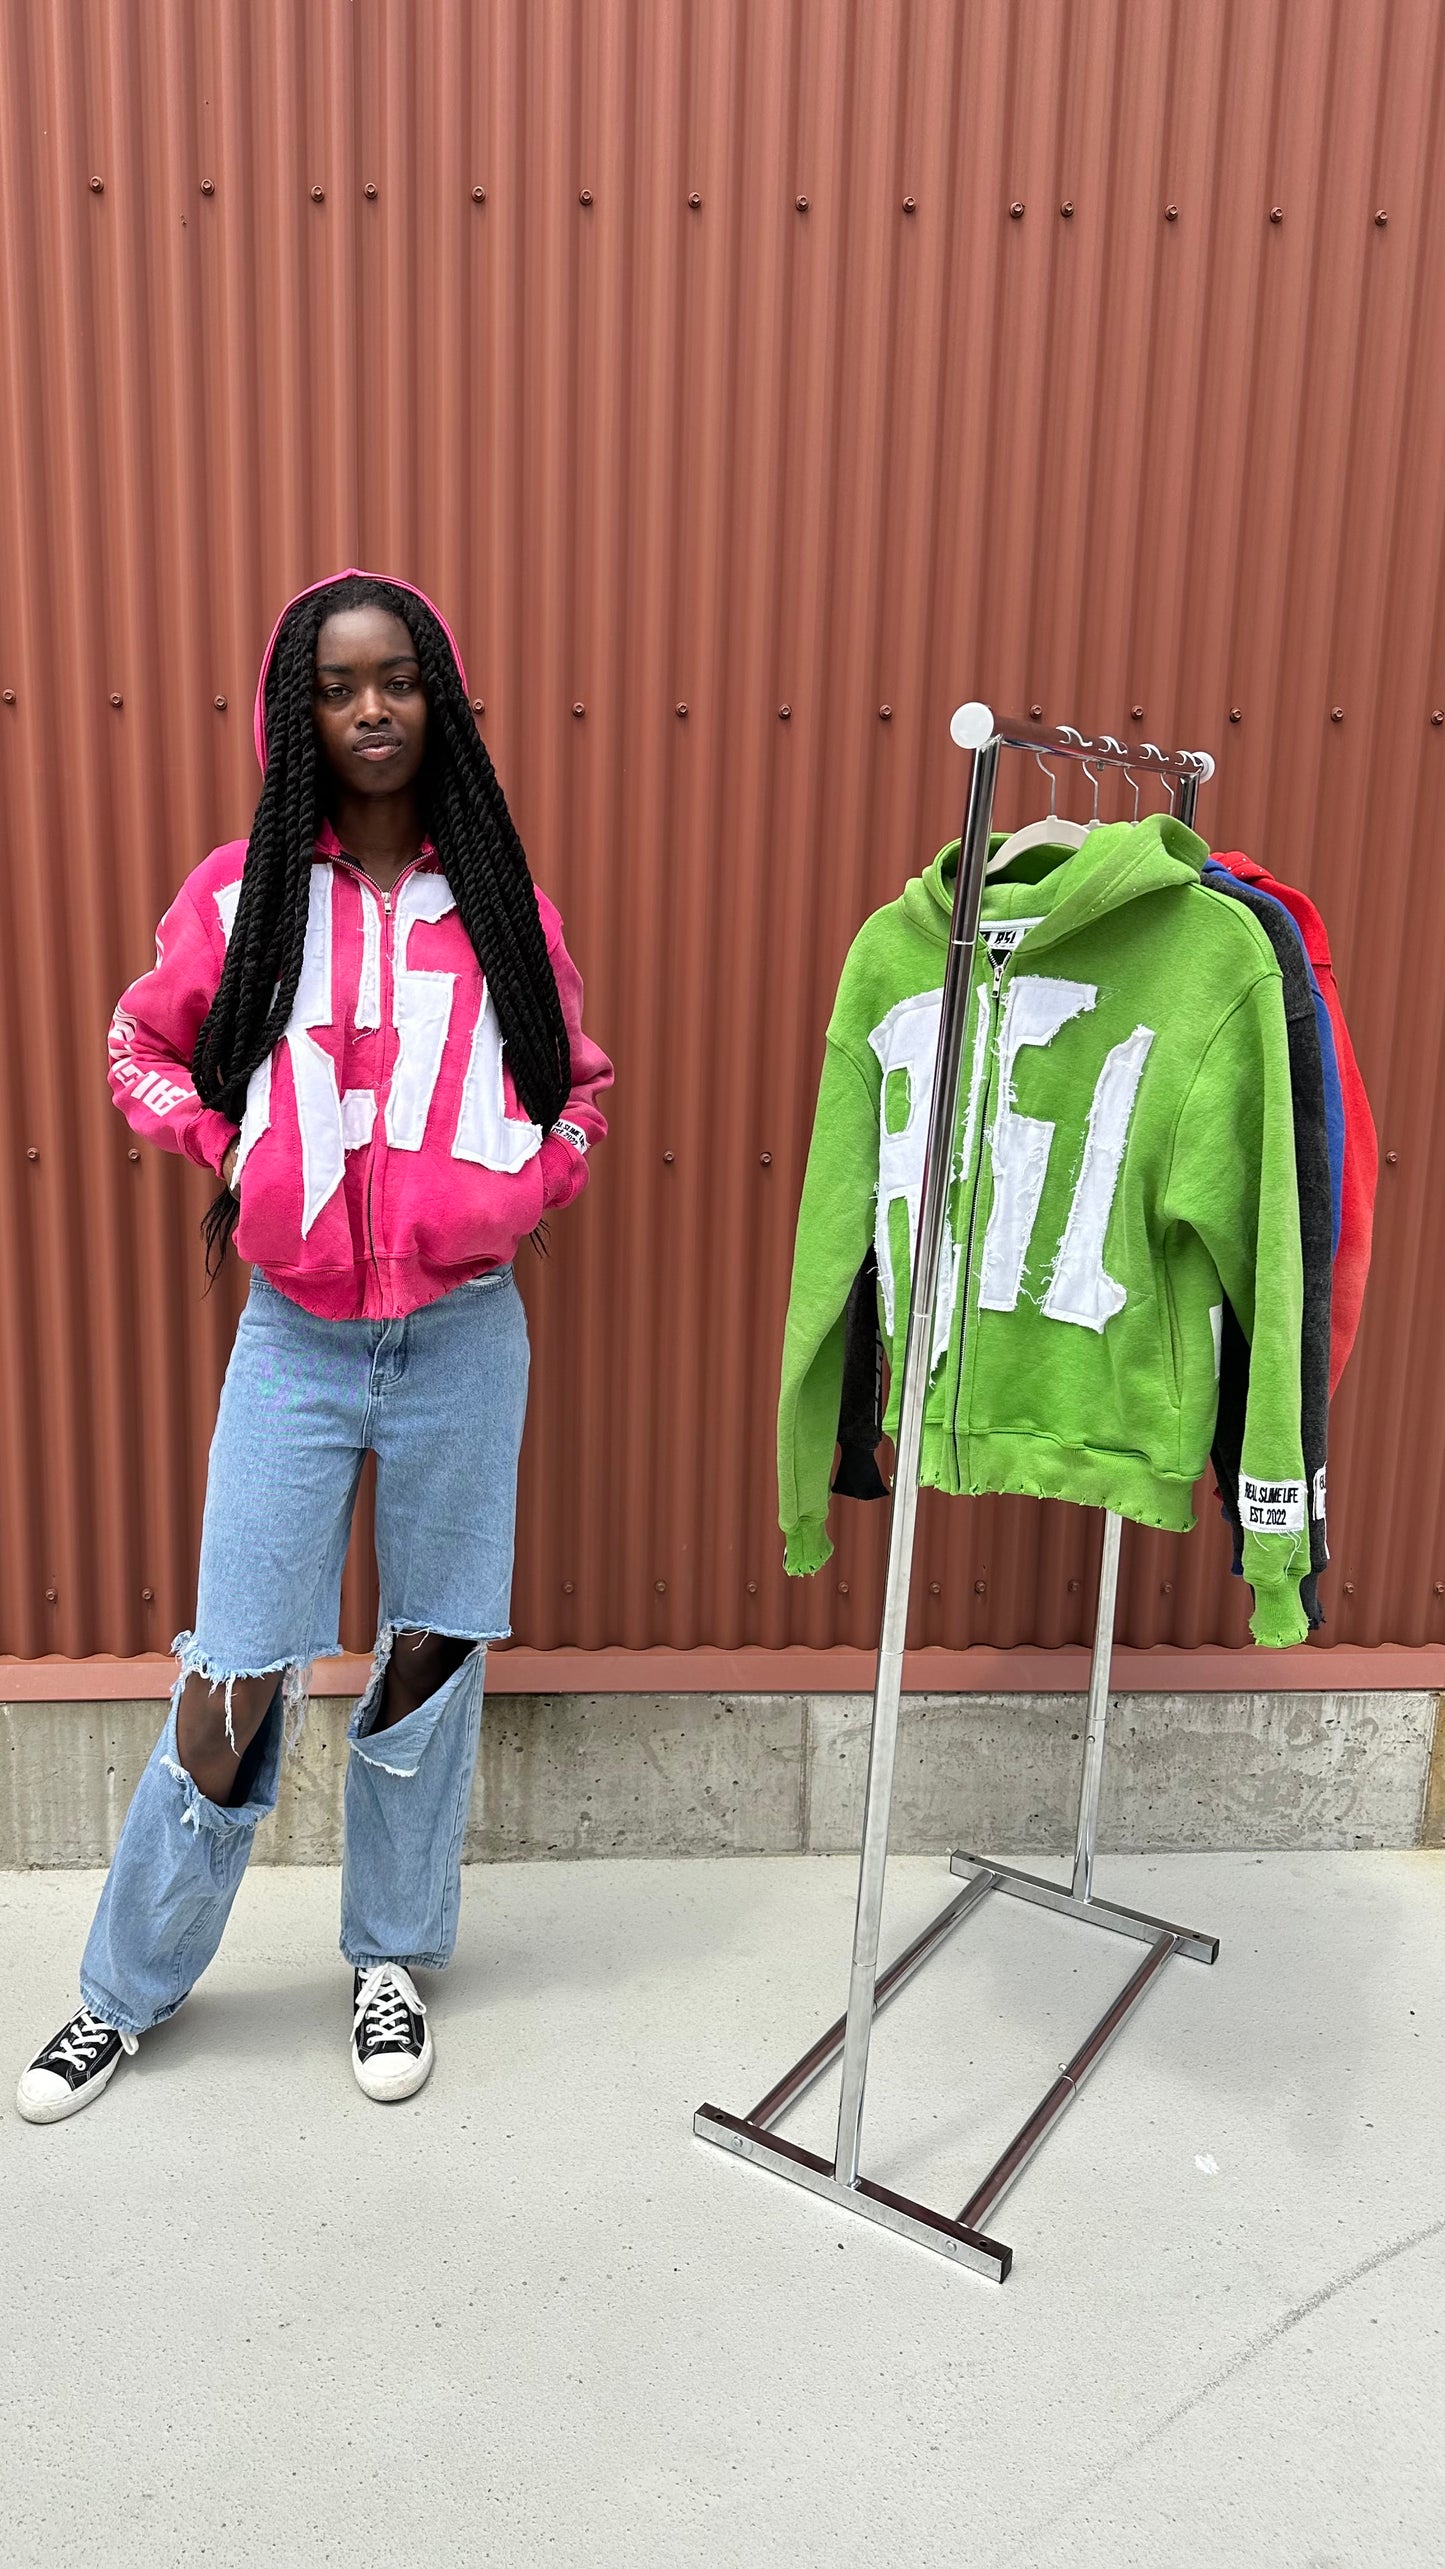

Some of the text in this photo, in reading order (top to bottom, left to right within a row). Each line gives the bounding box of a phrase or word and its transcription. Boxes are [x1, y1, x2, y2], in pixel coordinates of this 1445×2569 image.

[1244, 1481, 1299, 1504] REAL SLIME LIFE
[1249, 1505, 1287, 1526] EST. 2022
